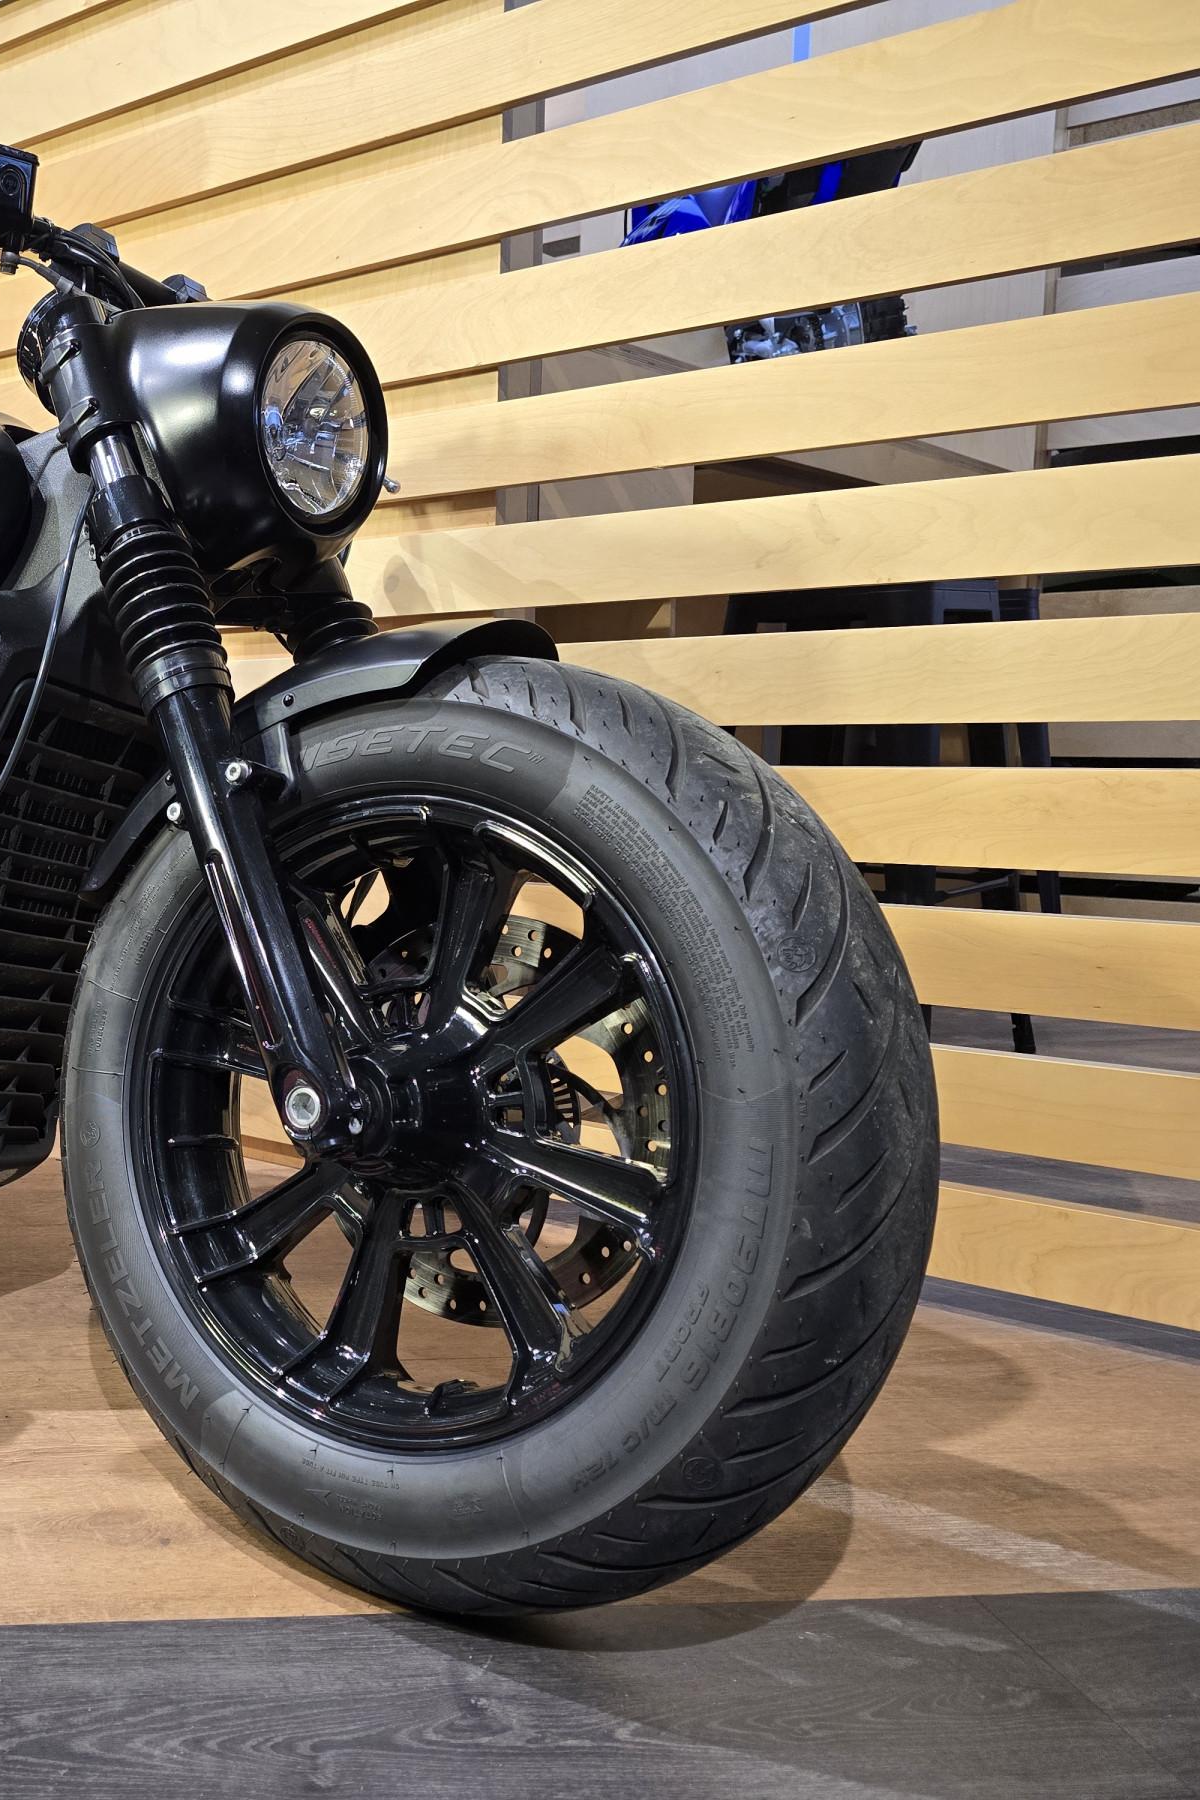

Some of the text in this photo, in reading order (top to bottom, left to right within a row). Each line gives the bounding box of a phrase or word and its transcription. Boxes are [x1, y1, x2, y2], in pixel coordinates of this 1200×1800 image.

[302, 724, 534, 774] ISETEC
[84, 1160, 199, 1408] METZELER
[657, 1281, 710, 1382] FRONT
